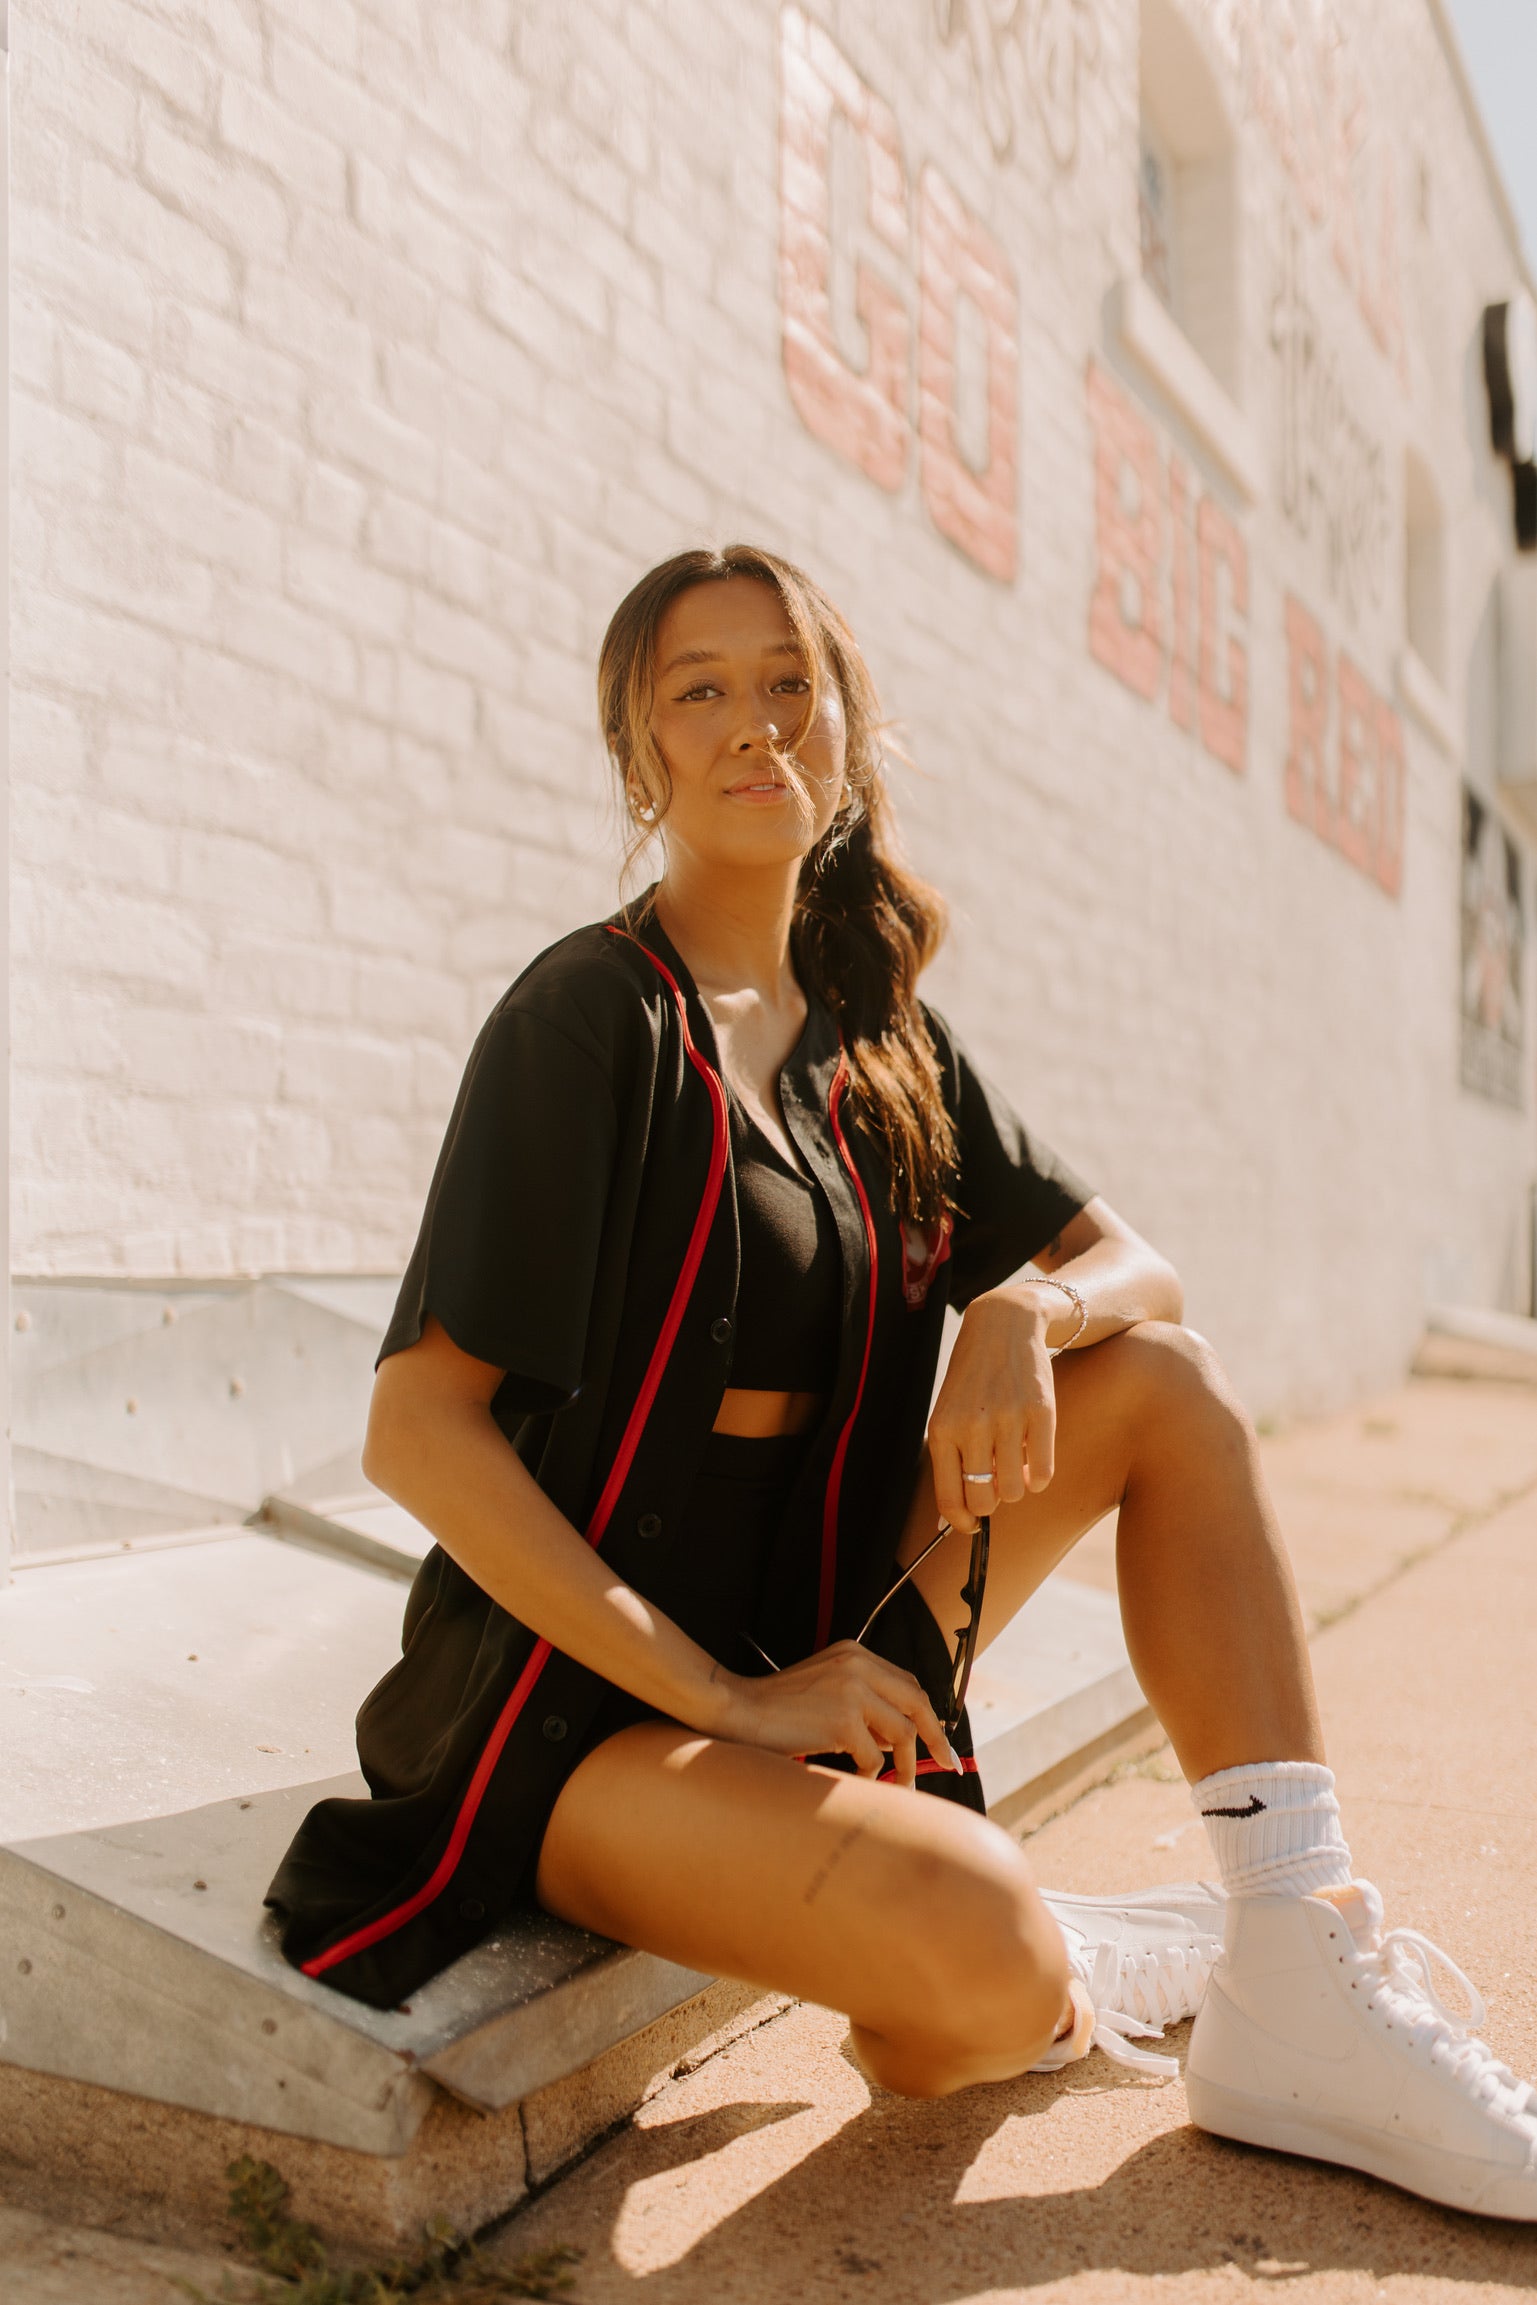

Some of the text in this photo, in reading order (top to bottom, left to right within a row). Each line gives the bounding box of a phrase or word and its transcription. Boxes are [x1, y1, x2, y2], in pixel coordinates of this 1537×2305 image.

[778, 3, 1020, 586] GO
[1086, 360, 1250, 777] BIG
[1283, 590, 1406, 902] RED
